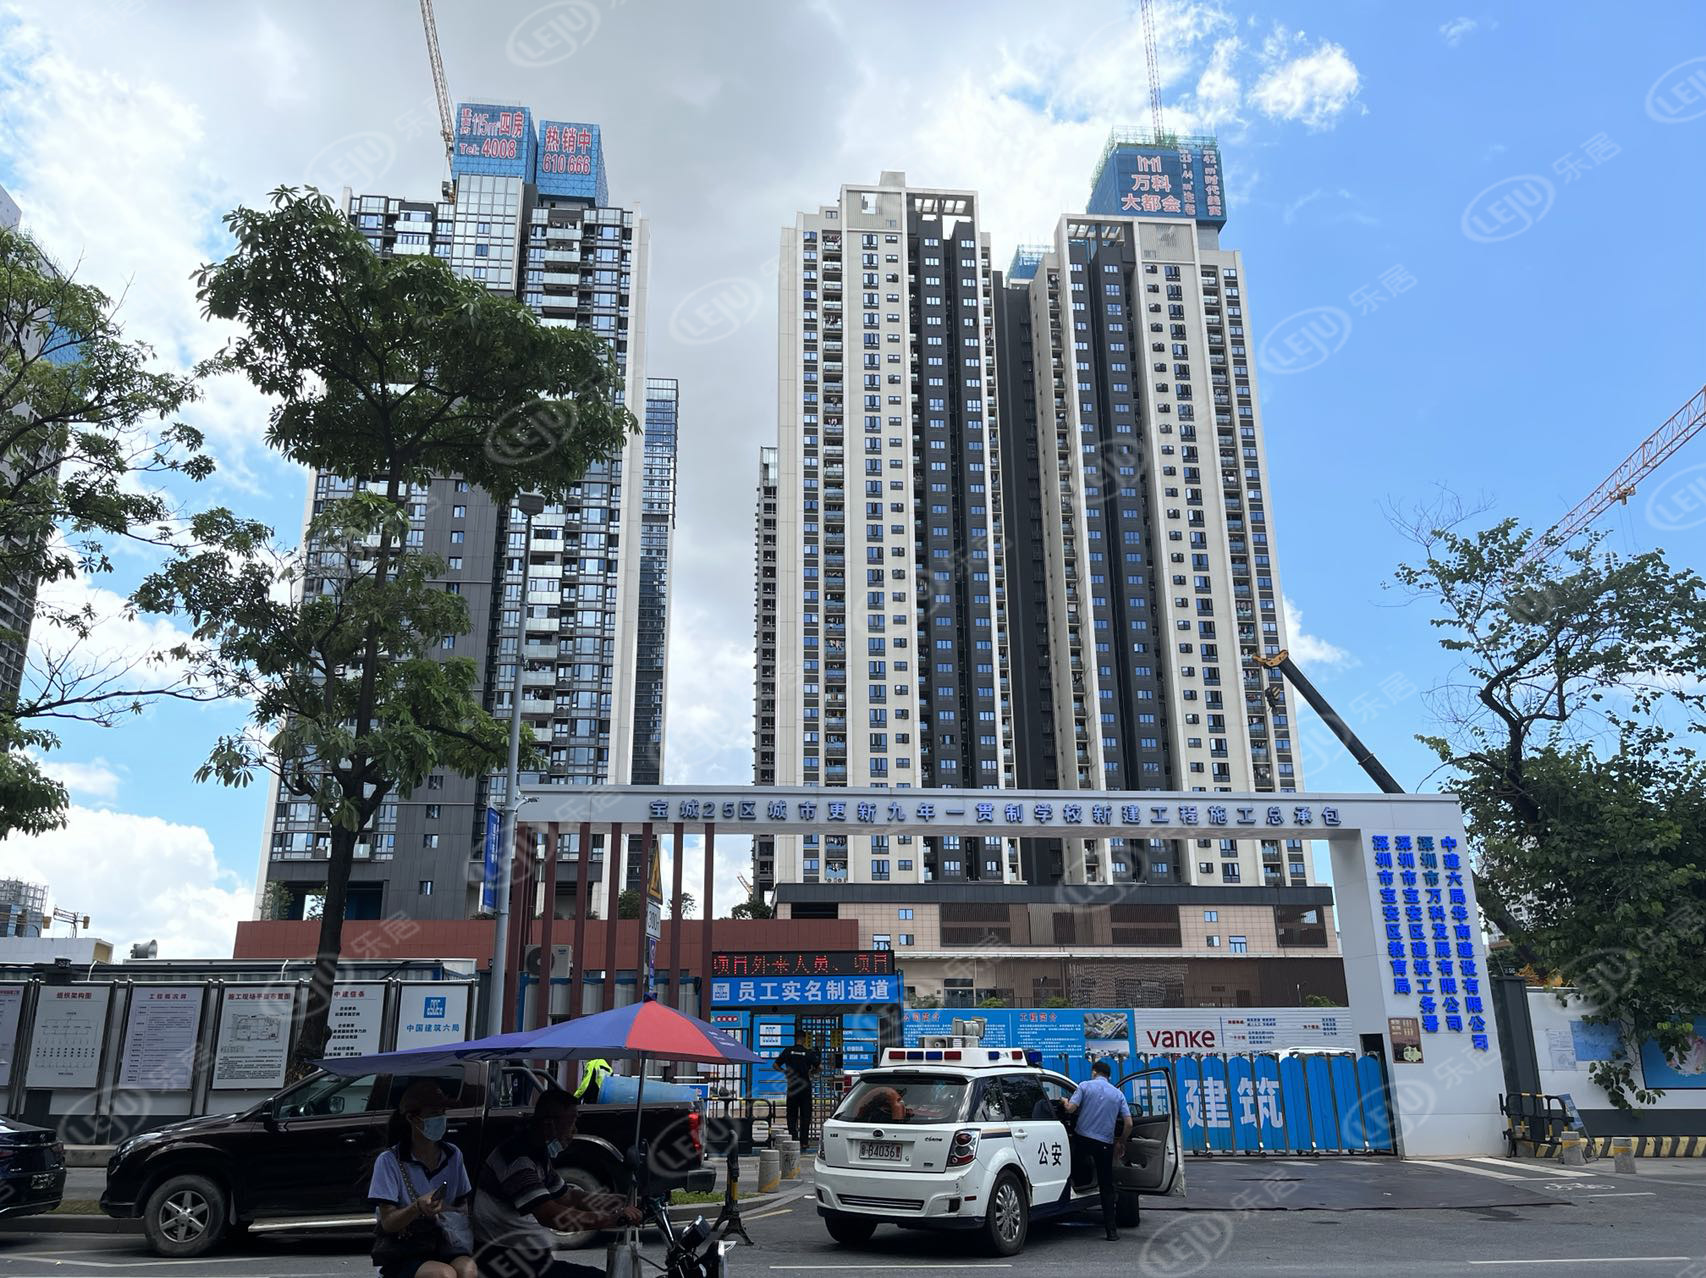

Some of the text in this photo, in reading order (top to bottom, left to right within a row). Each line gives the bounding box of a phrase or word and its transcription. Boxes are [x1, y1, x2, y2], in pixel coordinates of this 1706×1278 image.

[481, 138, 517, 159] 4008
[545, 125, 592, 154] 热销中
[543, 153, 591, 175] 610 666
[1131, 174, 1172, 193] 万科
[1121, 193, 1181, 213] 大都会
[649, 800, 1342, 826] 宝城25区城市更新九年一贯制学校新建工程施工总承包
[1372, 836, 1411, 995] 深圳市宝安区教育局
[1395, 836, 1440, 1033] 深圳市宝安区建筑工务署
[1417, 836, 1463, 1032] 深圳市万科发展有限公司
[1440, 836, 1489, 1052] 中建六局华南建设有限公司
[738, 979, 890, 1002] 员工实名制通道
[406, 1023, 460, 1033] 中国建筑六局
[1146, 1030, 1215, 1048] vanke
[1037, 1141, 1062, 1166] 公安
